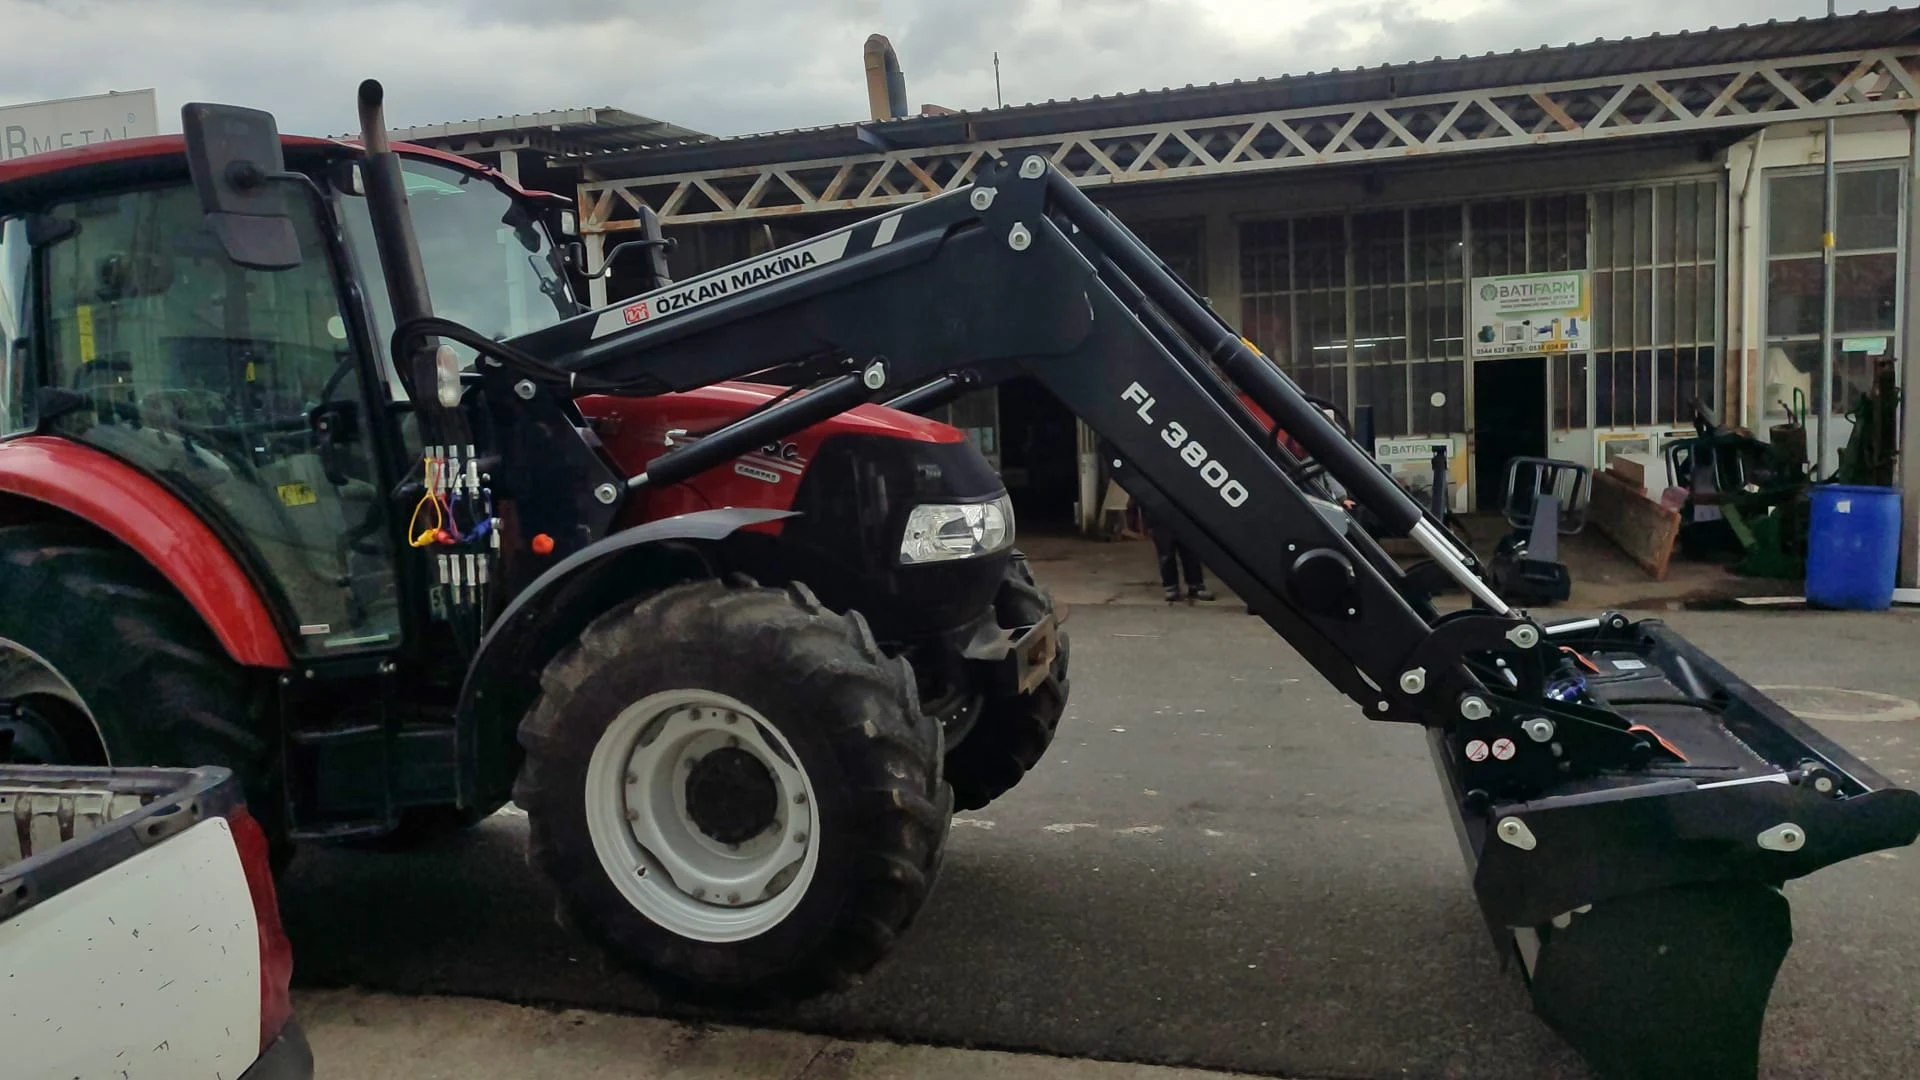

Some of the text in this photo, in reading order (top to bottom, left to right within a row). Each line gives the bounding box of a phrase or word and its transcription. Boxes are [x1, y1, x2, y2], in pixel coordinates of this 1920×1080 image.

[656, 250, 817, 315] ÖZKAN MAKİNA
[1499, 281, 1576, 298] BATIFARM
[1120, 381, 1249, 508] FL 3800
